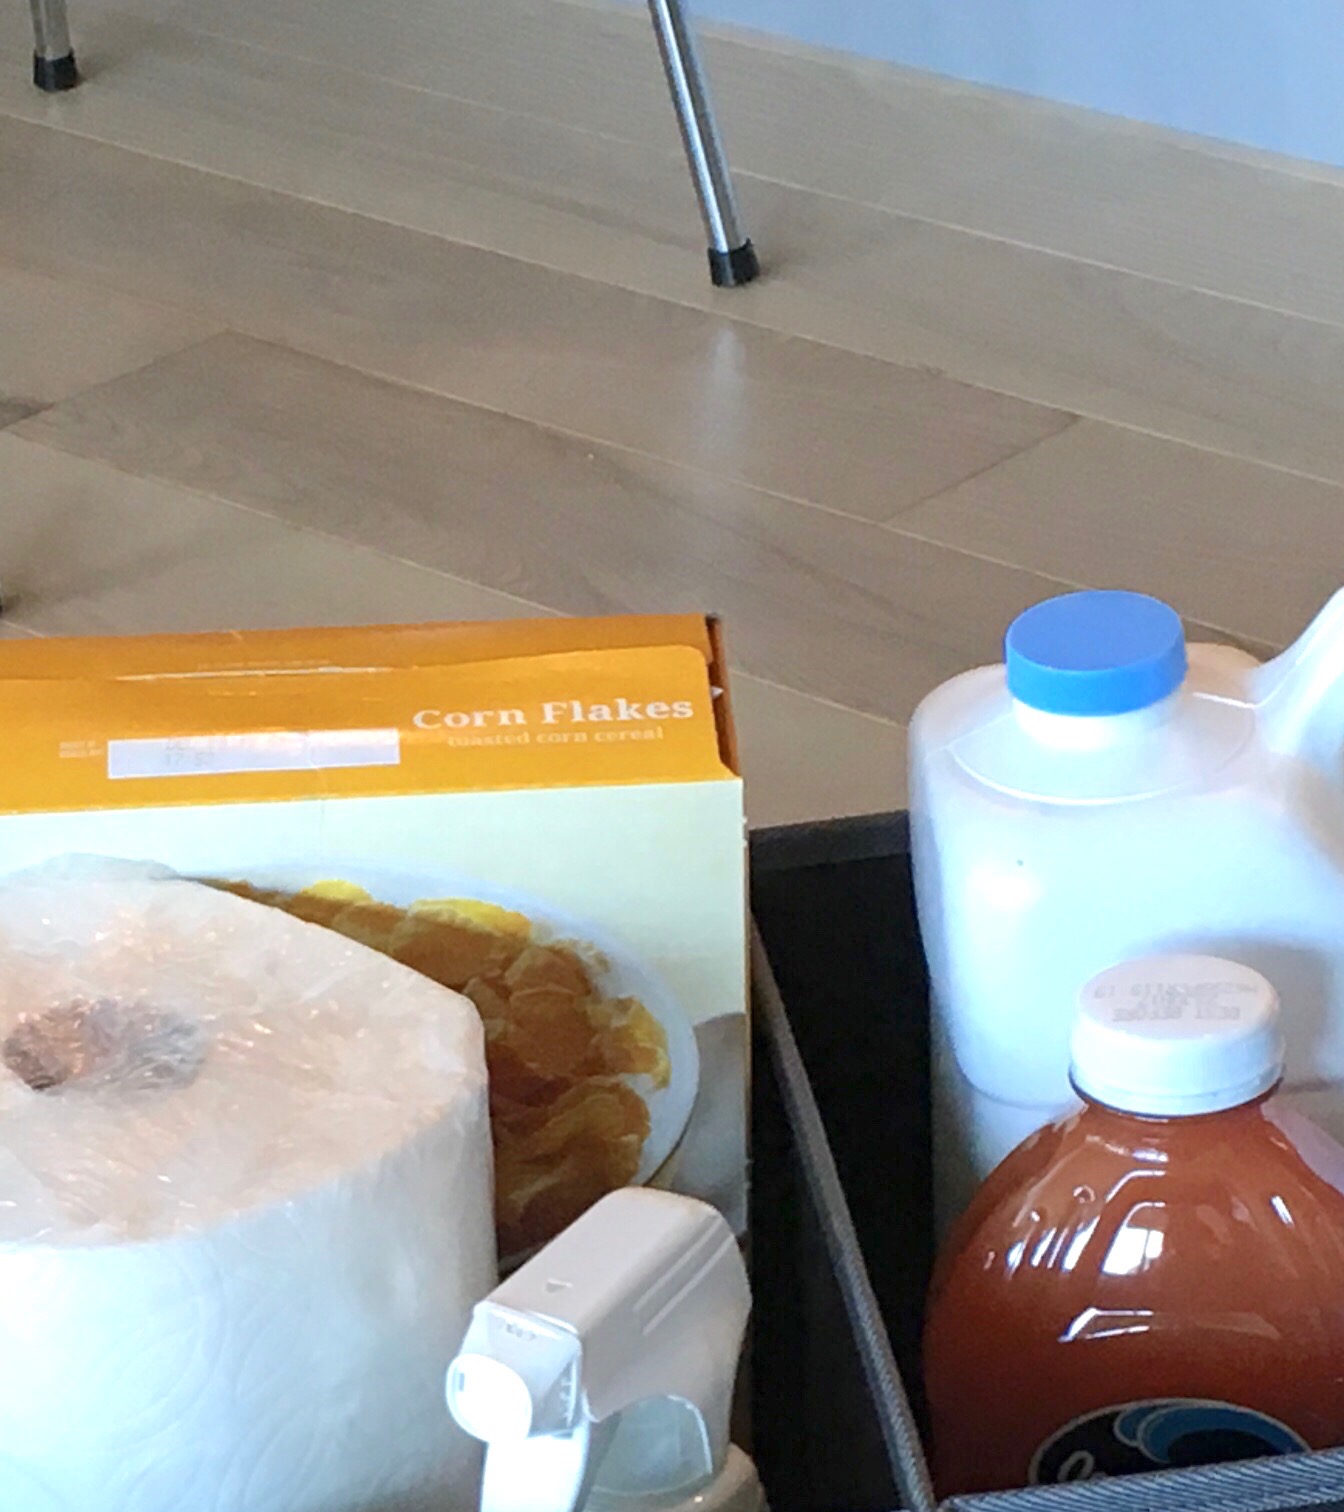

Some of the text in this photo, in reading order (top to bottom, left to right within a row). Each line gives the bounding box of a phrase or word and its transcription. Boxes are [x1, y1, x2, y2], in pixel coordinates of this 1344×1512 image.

[412, 698, 694, 730] Corn Flakes
[447, 726, 664, 747] toasted corn cereal
